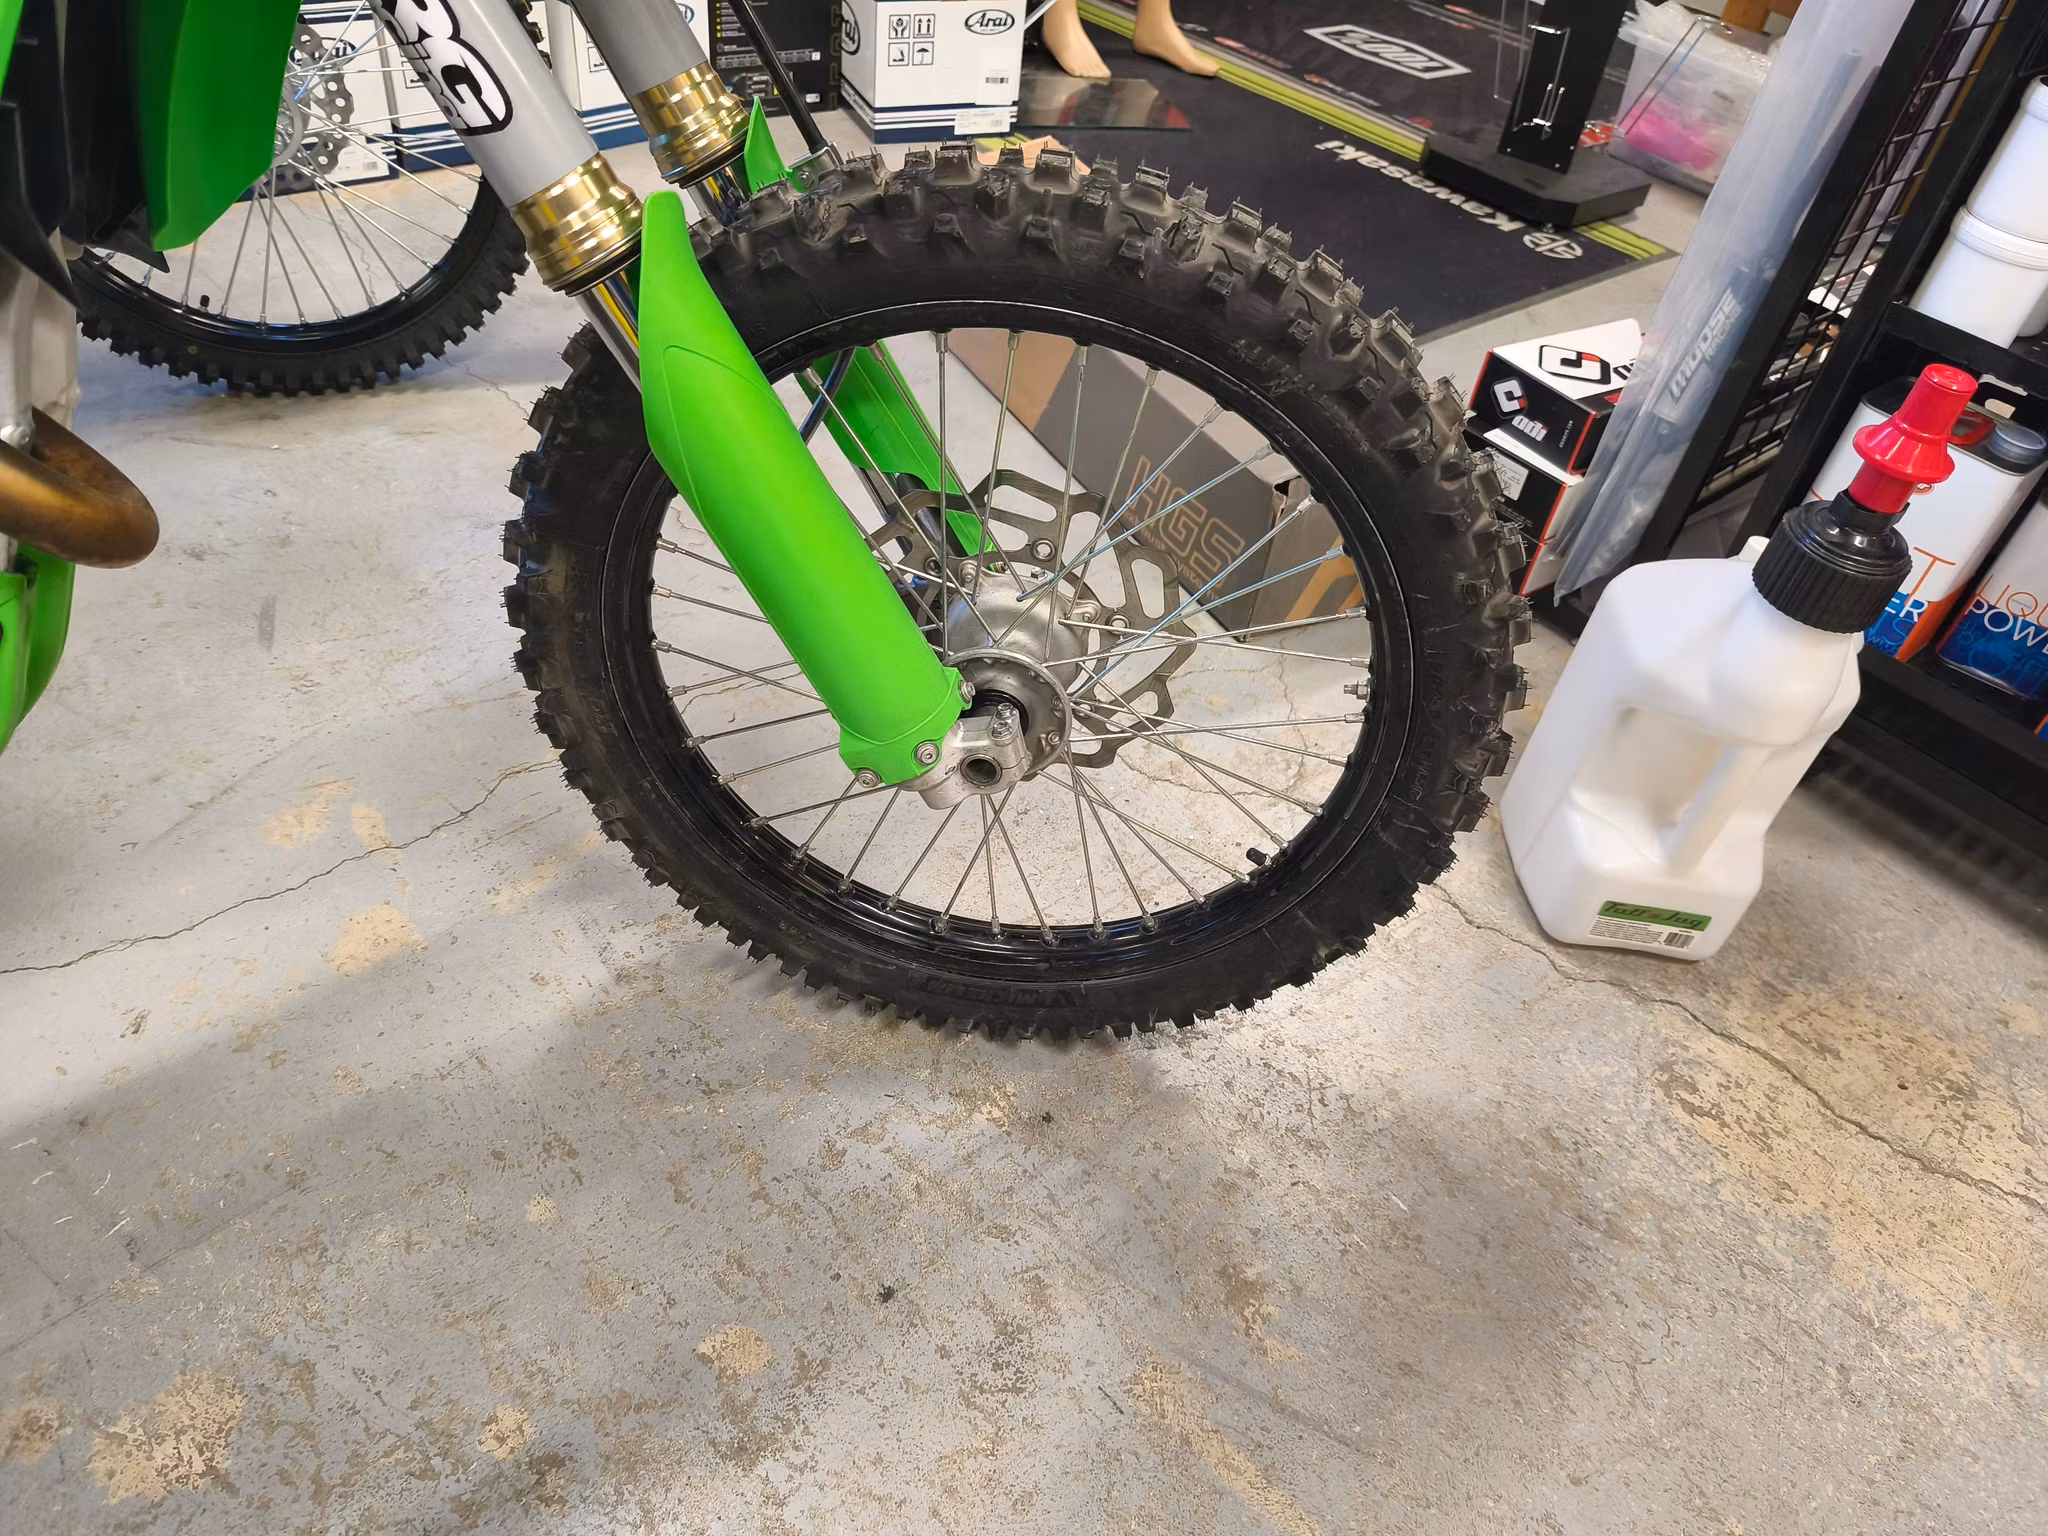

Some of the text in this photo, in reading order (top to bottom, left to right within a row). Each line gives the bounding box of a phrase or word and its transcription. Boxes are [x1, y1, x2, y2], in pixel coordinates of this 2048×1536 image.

[968, 12, 1012, 29] Arai
[1326, 30, 1447, 71] 100%
[1314, 140, 1527, 232] Kawasaki
[1704, 305, 1742, 361] RACING
[1512, 415, 1549, 442] odi
[1126, 455, 1246, 586] HGS
[1965, 595, 2048, 656] POW
